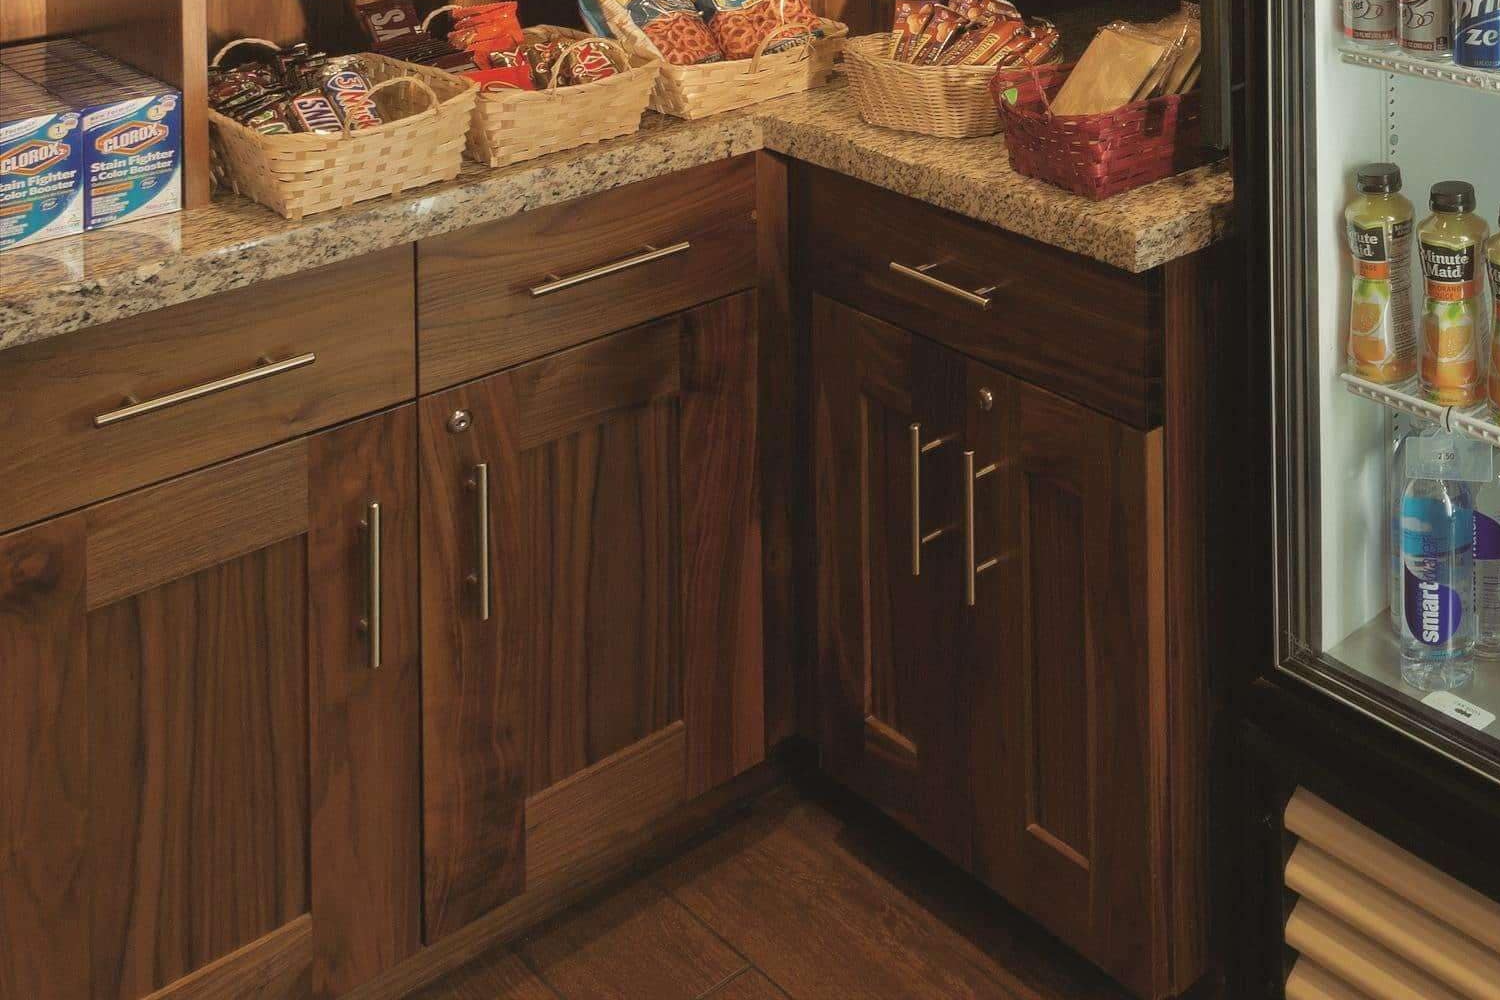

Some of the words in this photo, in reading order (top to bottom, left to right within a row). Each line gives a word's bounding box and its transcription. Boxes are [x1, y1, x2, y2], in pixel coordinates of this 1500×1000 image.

[103, 124, 160, 154] CLOROX
[91, 159, 127, 173] Stain
[129, 150, 175, 167] Fighter
[99, 168, 128, 182] Color
[130, 159, 173, 175] Booster
[28, 170, 77, 186] Fighter
[29, 180, 76, 196] Booster
